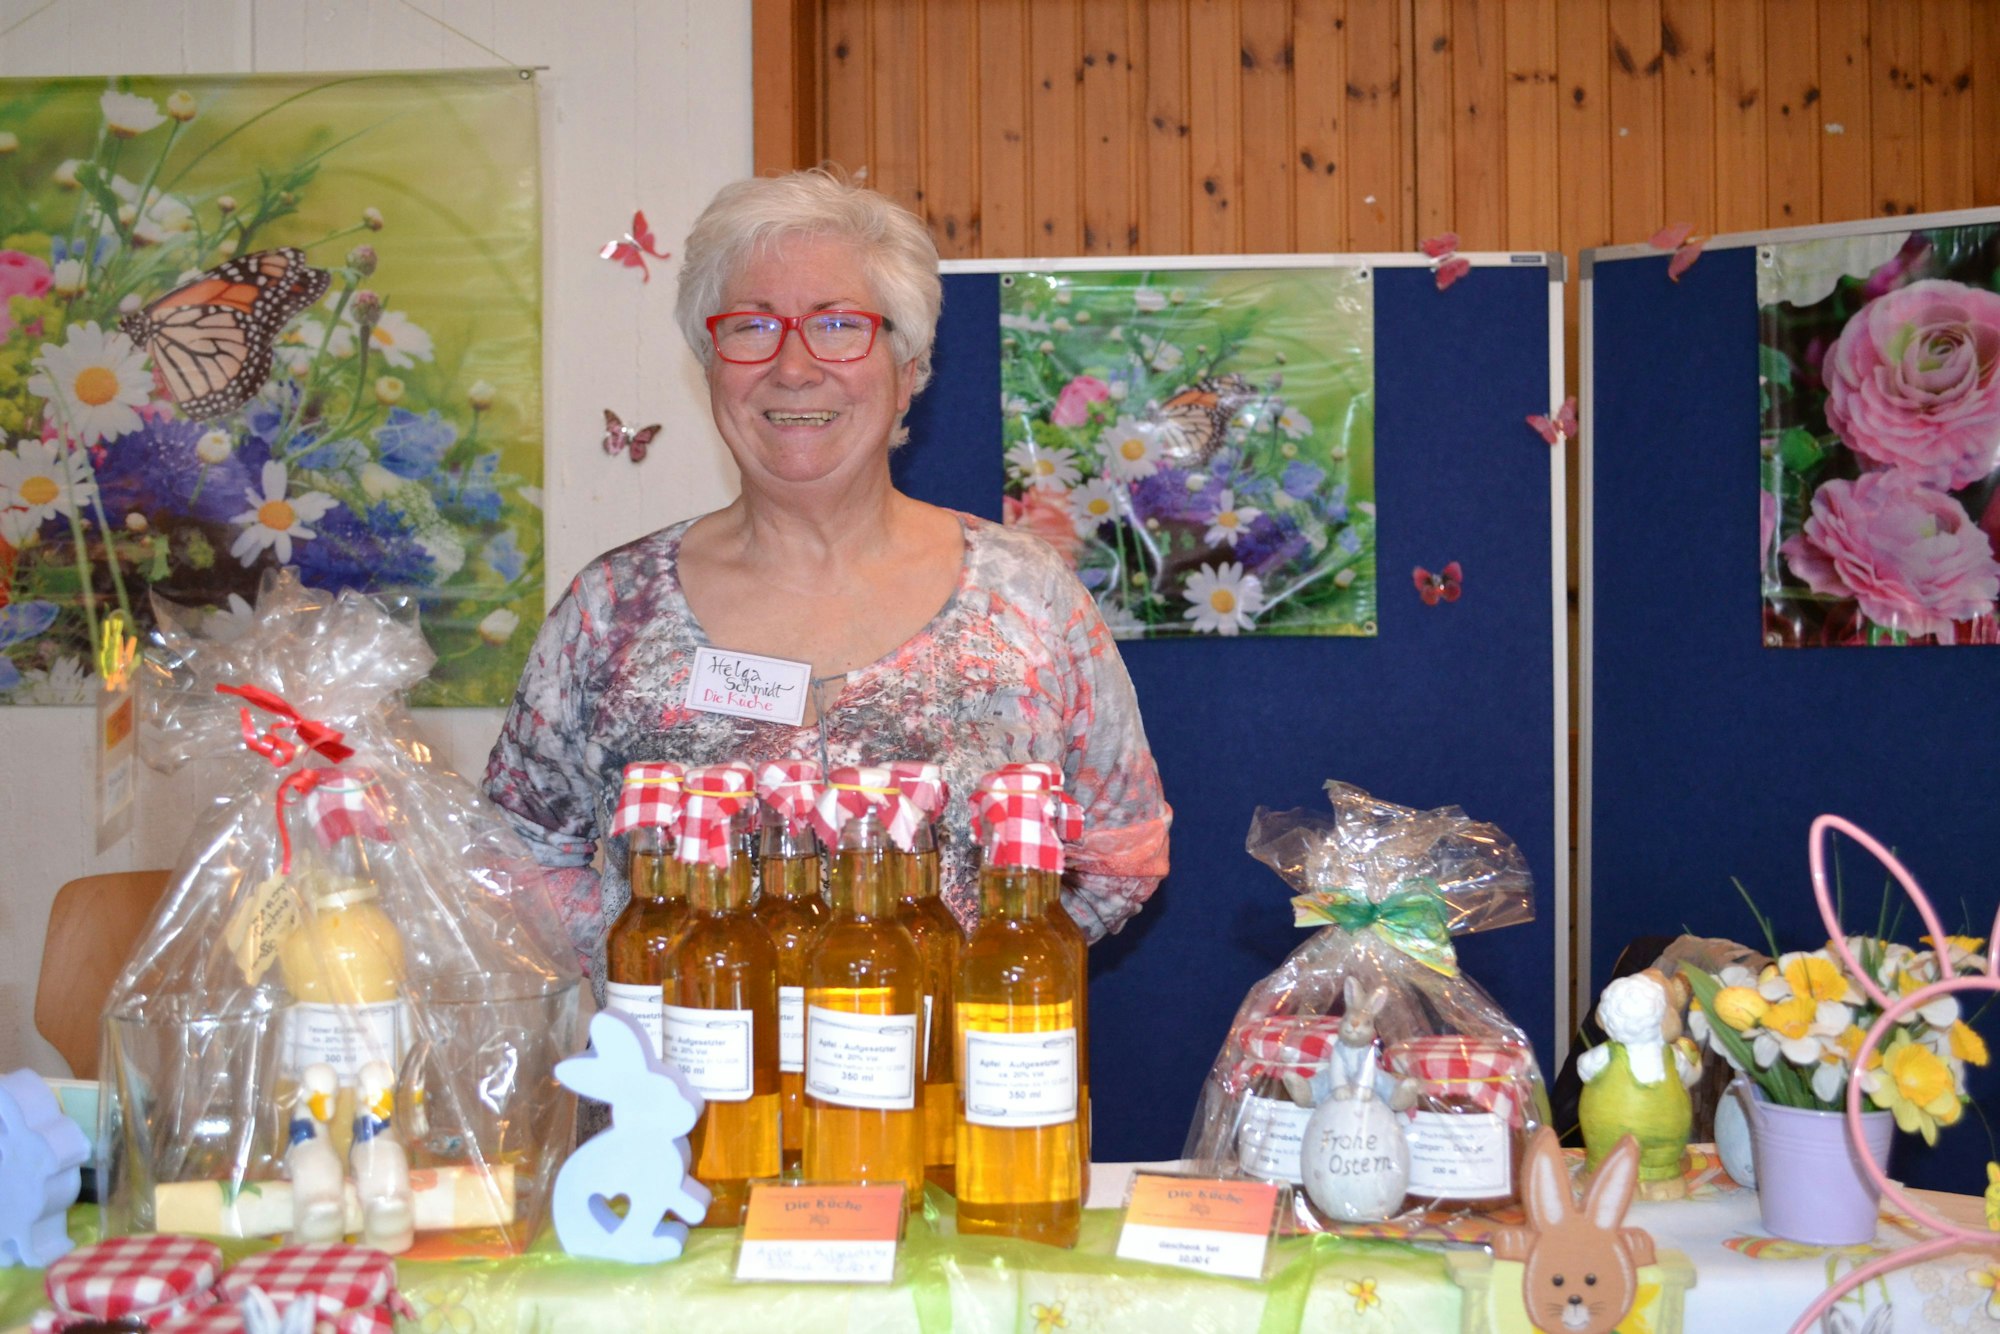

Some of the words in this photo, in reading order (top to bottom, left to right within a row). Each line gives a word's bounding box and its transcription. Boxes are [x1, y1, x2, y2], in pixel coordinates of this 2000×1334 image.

[707, 656, 762, 684] Helga
[725, 676, 795, 698] Schmidt
[704, 688, 723, 704] Die
[727, 692, 774, 711] Küche
[678, 1036, 726, 1047] Aufgesetzter
[818, 1038, 837, 1048] Apfel
[844, 1043, 896, 1053] Aufgesetzter
[693, 1066, 705, 1075] ml
[980, 1059, 1001, 1068] Apfel
[1009, 1059, 1060, 1069] Aufgesetzter
[841, 1071, 858, 1081] 350
[861, 1073, 874, 1082] ml
[1009, 1090, 1026, 1099] 350
[1029, 1090, 1042, 1099] ml
[1320, 1129, 1378, 1152] Frohe
[1329, 1154, 1393, 1176] Ostern
[784, 1199, 811, 1212] Die
[815, 1197, 863, 1212] Küche
[1168, 1189, 1193, 1200] Die
[1198, 1189, 1244, 1205] Küche
